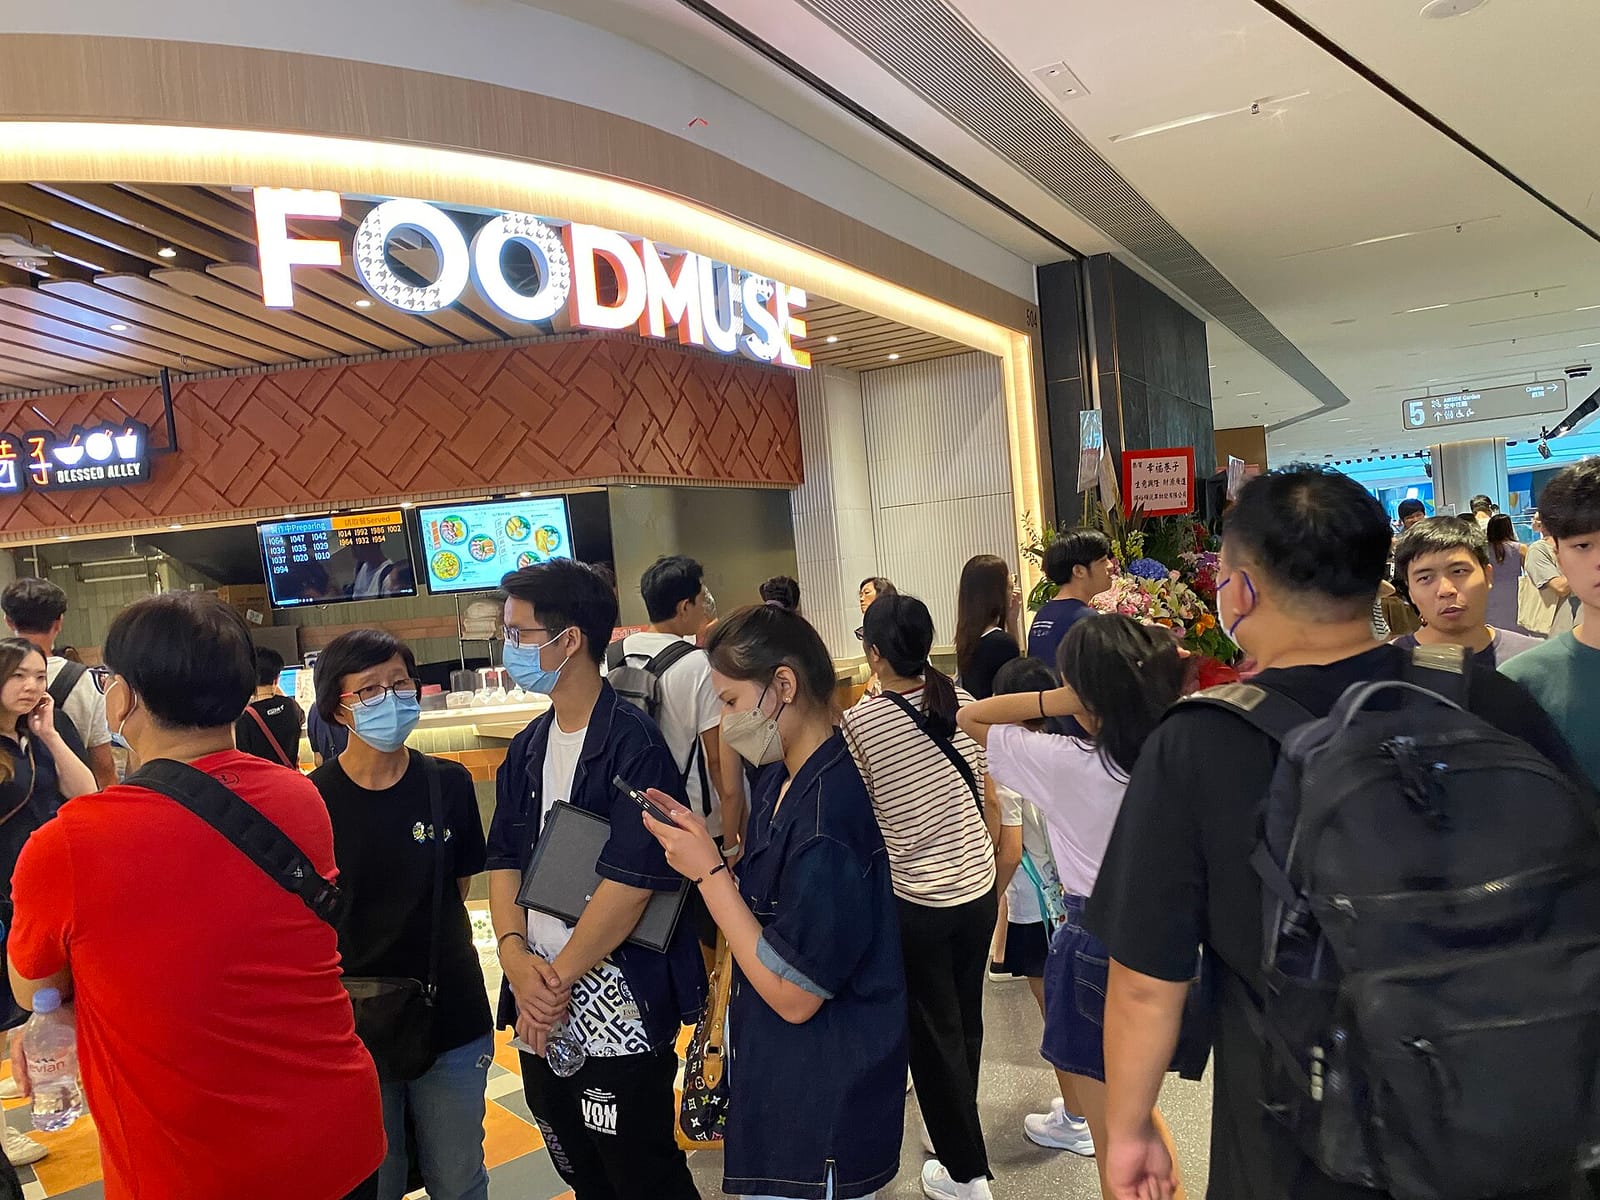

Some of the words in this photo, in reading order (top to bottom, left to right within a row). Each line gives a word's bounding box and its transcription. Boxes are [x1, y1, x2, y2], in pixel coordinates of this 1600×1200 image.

[252, 187, 811, 369] FOODMUSE
[1026, 308, 1038, 329] 504
[1408, 401, 1426, 427] 5
[57, 466, 105, 483] BLESSED
[107, 463, 140, 478] ALLEY
[290, 535, 305, 543] 1047
[312, 532, 327, 541] 1042
[338, 530, 352, 538] 1014
[354, 528, 368, 536] 1992
[387, 525, 402, 533] 1002
[355, 537, 370, 545] 1932
[372, 535, 386, 543] 1954
[270, 546, 286, 555] 1036
[291, 544, 307, 552] 1035
[313, 542, 329, 551] 1029
[271, 555, 287, 564] 1037
[293, 553, 309, 562] 1020
[314, 551, 331, 560] 1010
[273, 565, 289, 574] 1994
[30, 1059, 65, 1073] evian
[581, 1098, 618, 1130] VON
